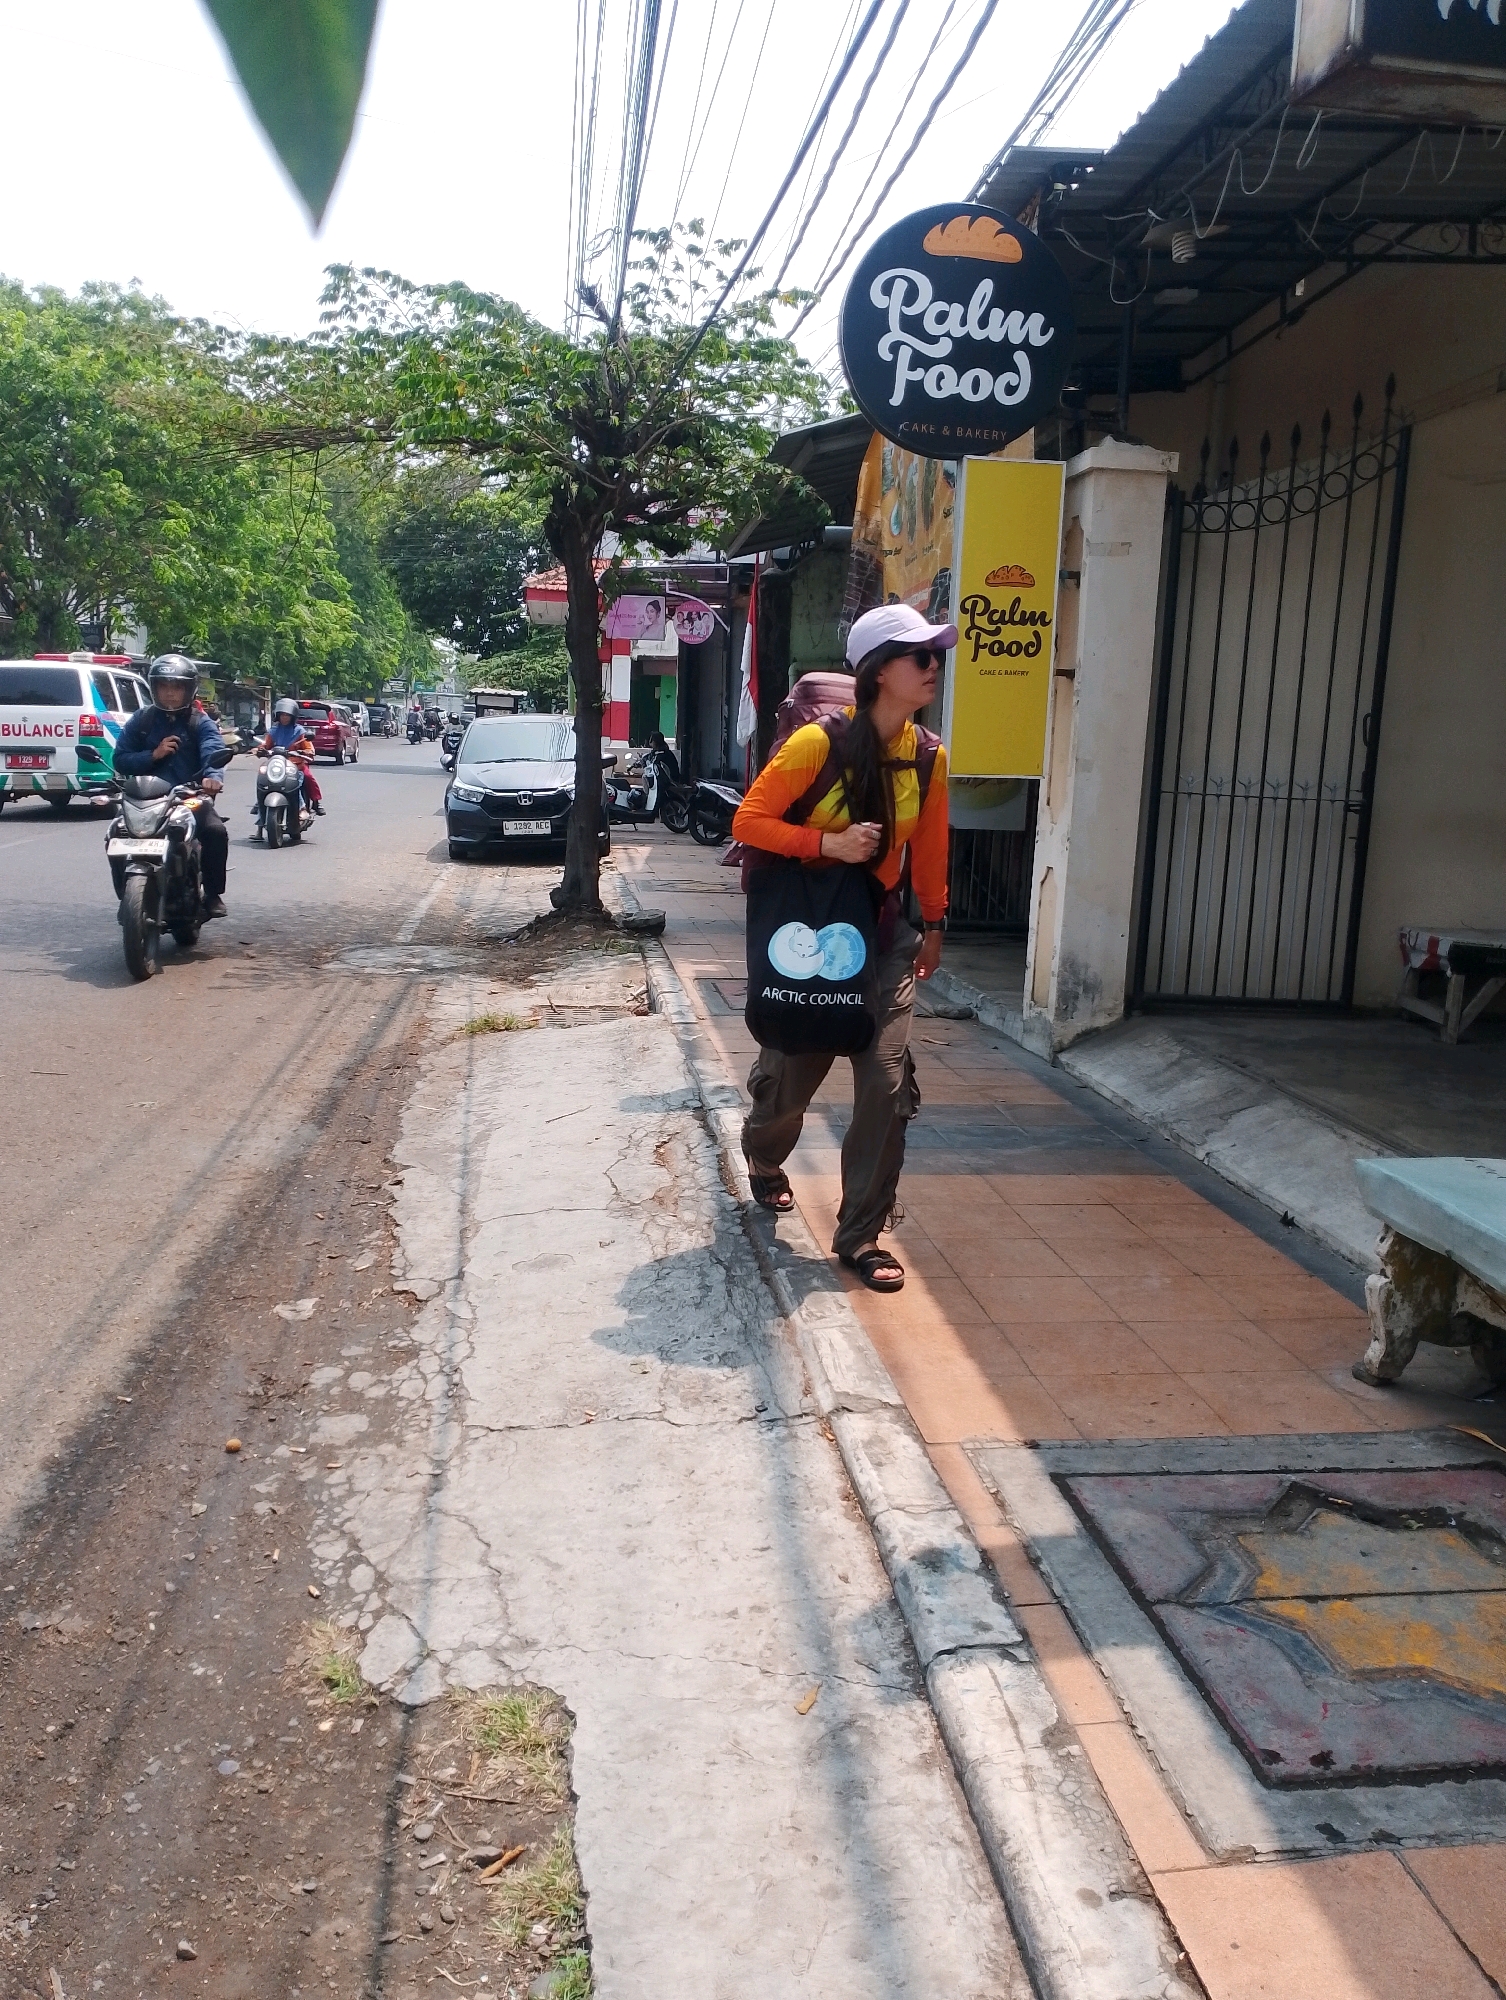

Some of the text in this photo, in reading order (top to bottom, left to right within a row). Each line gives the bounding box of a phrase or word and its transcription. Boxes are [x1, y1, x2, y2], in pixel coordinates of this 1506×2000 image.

[869, 267, 1055, 348] Palm
[877, 332, 1032, 407] Food
[902, 421, 1007, 441] CAKE & BAKERY
[960, 594, 1052, 628] Palm
[965, 625, 1042, 663] Food
[1004, 669, 1030, 677] BAKERY
[18, 755, 33, 764] 1329
[38, 755, 47, 764] PP
[504, 822, 510, 831] L
[762, 987, 864, 1005] ARCTIC COUNCIL
